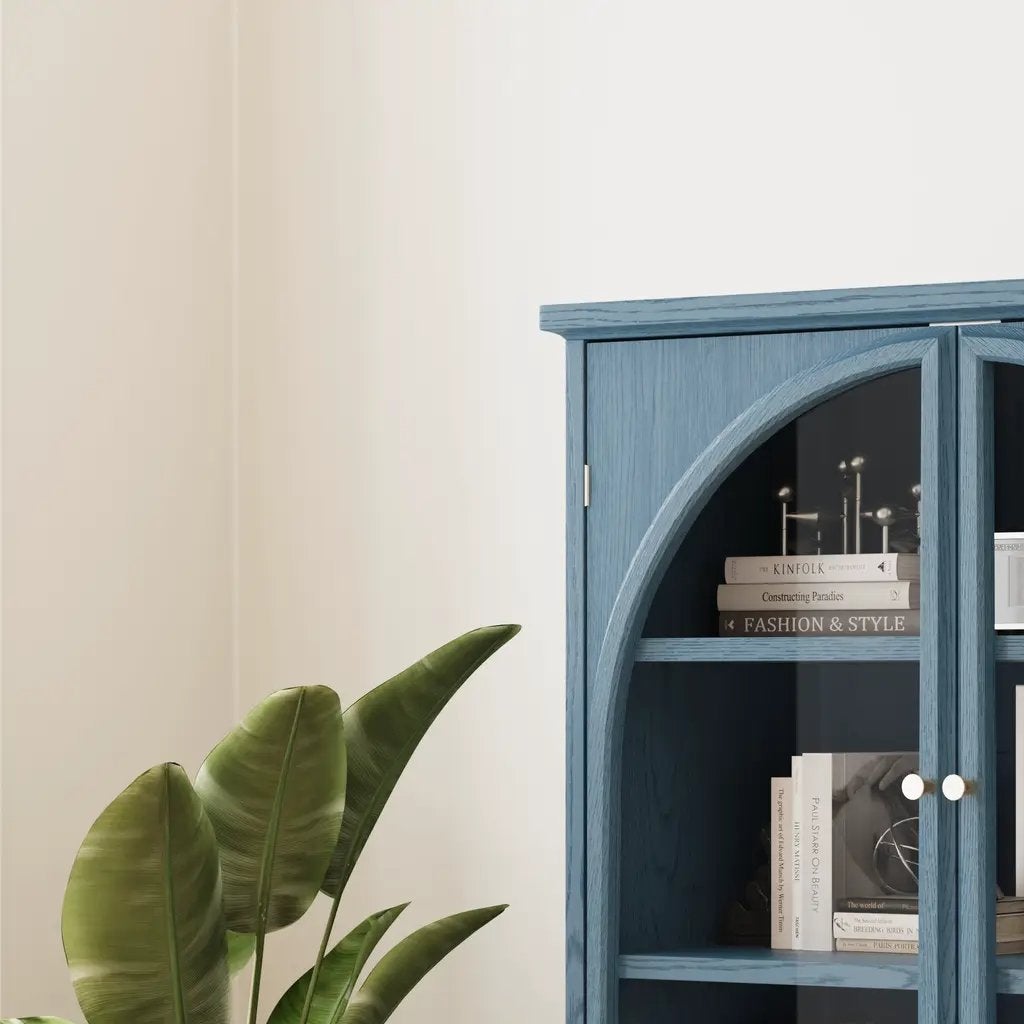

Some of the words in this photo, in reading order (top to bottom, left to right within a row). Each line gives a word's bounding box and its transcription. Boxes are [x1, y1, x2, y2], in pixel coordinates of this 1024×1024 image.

[773, 562, 825, 575] KINFOLK
[762, 591, 810, 604] Constructing
[812, 591, 844, 602] Paradies
[744, 617, 824, 633] FASHION
[829, 616, 843, 631] &
[848, 616, 905, 632] STYLE
[811, 797, 819, 823] PAUL
[811, 825, 819, 854] STARR
[811, 857, 820, 875] ON
[847, 901, 858, 909] The
[860, 901, 877, 909] world
